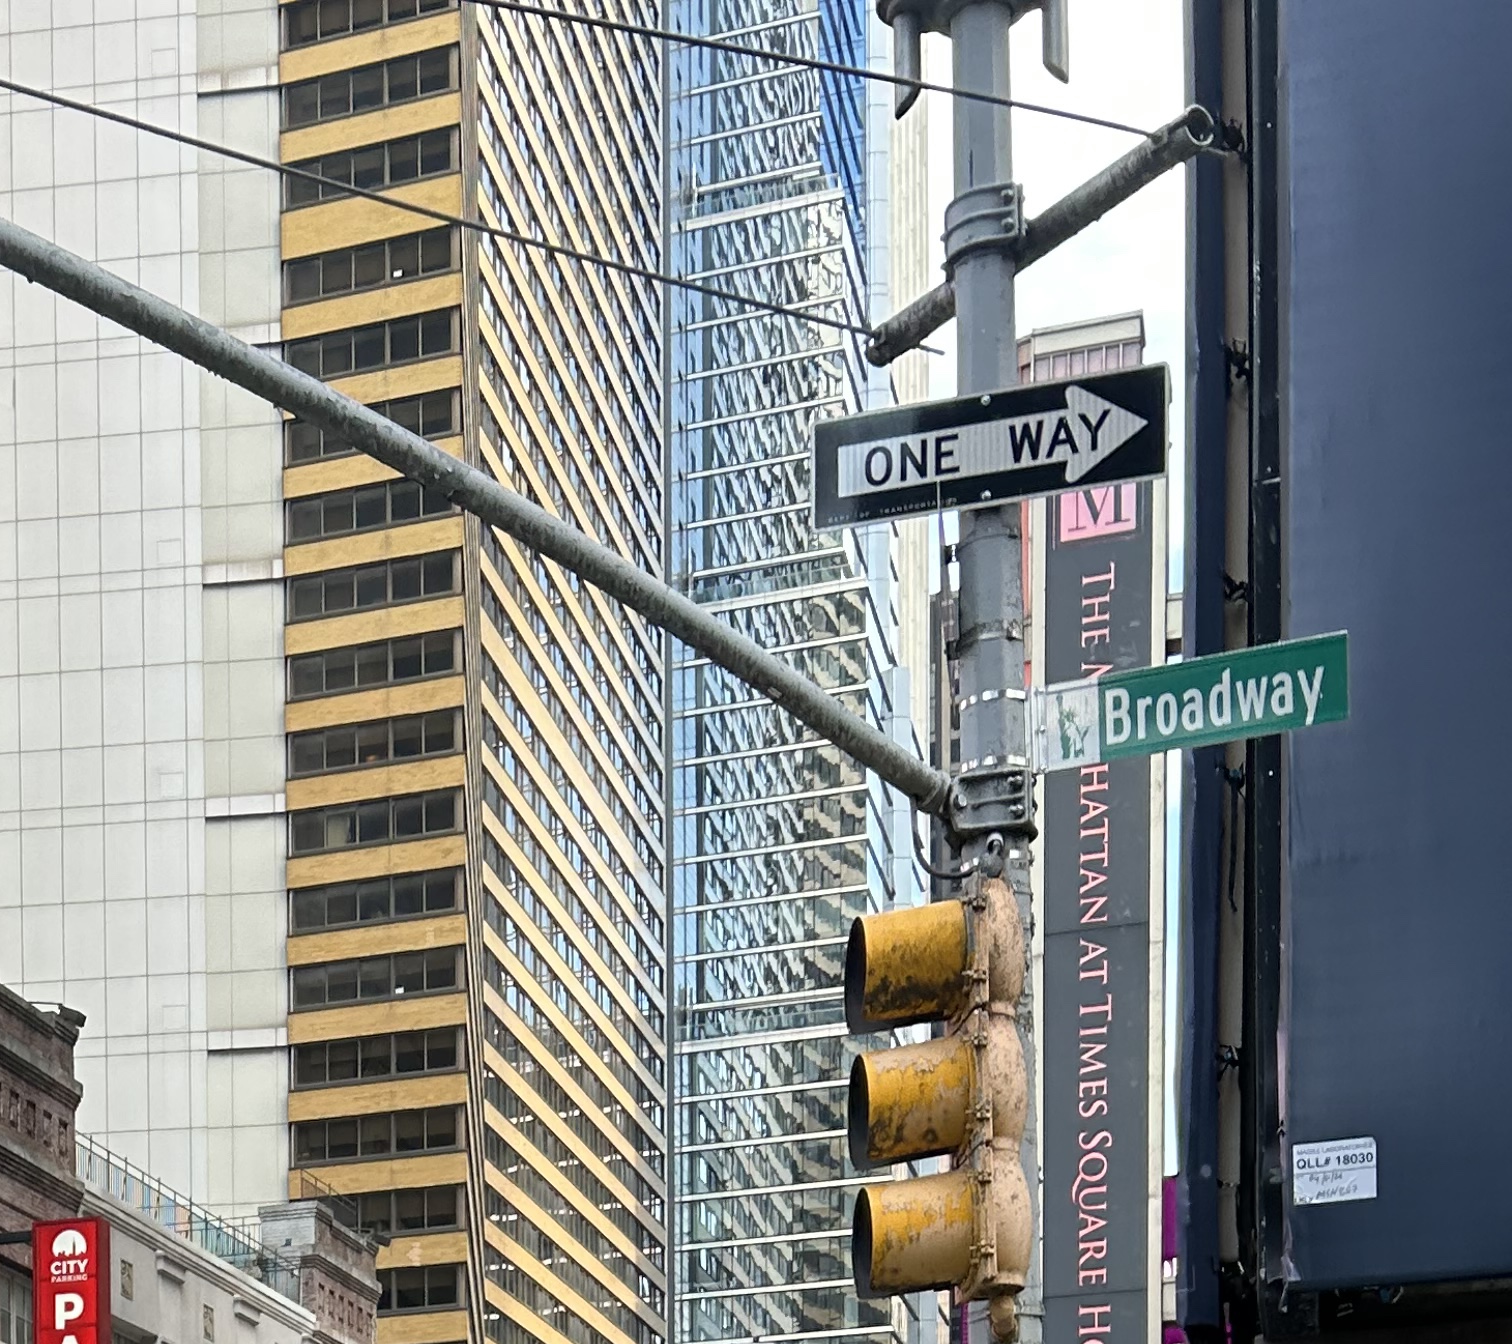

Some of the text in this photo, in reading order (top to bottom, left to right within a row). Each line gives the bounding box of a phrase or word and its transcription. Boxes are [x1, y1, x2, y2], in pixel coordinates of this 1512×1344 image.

[864, 409, 1111, 487] ONE WAY
[1081, 561, 1115, 648] THE
[1104, 665, 1325, 746] Broadway
[1079, 663, 1114, 925] HATTAN
[1079, 937, 1108, 985] AT
[1079, 993, 1112, 1118] TIMES
[1336, 1152, 1374, 1166] 18030
[1072, 1130, 1112, 1288] SQUARE
[50, 1258, 88, 1275] CITY
[51, 1273, 87, 1284] PARKING
